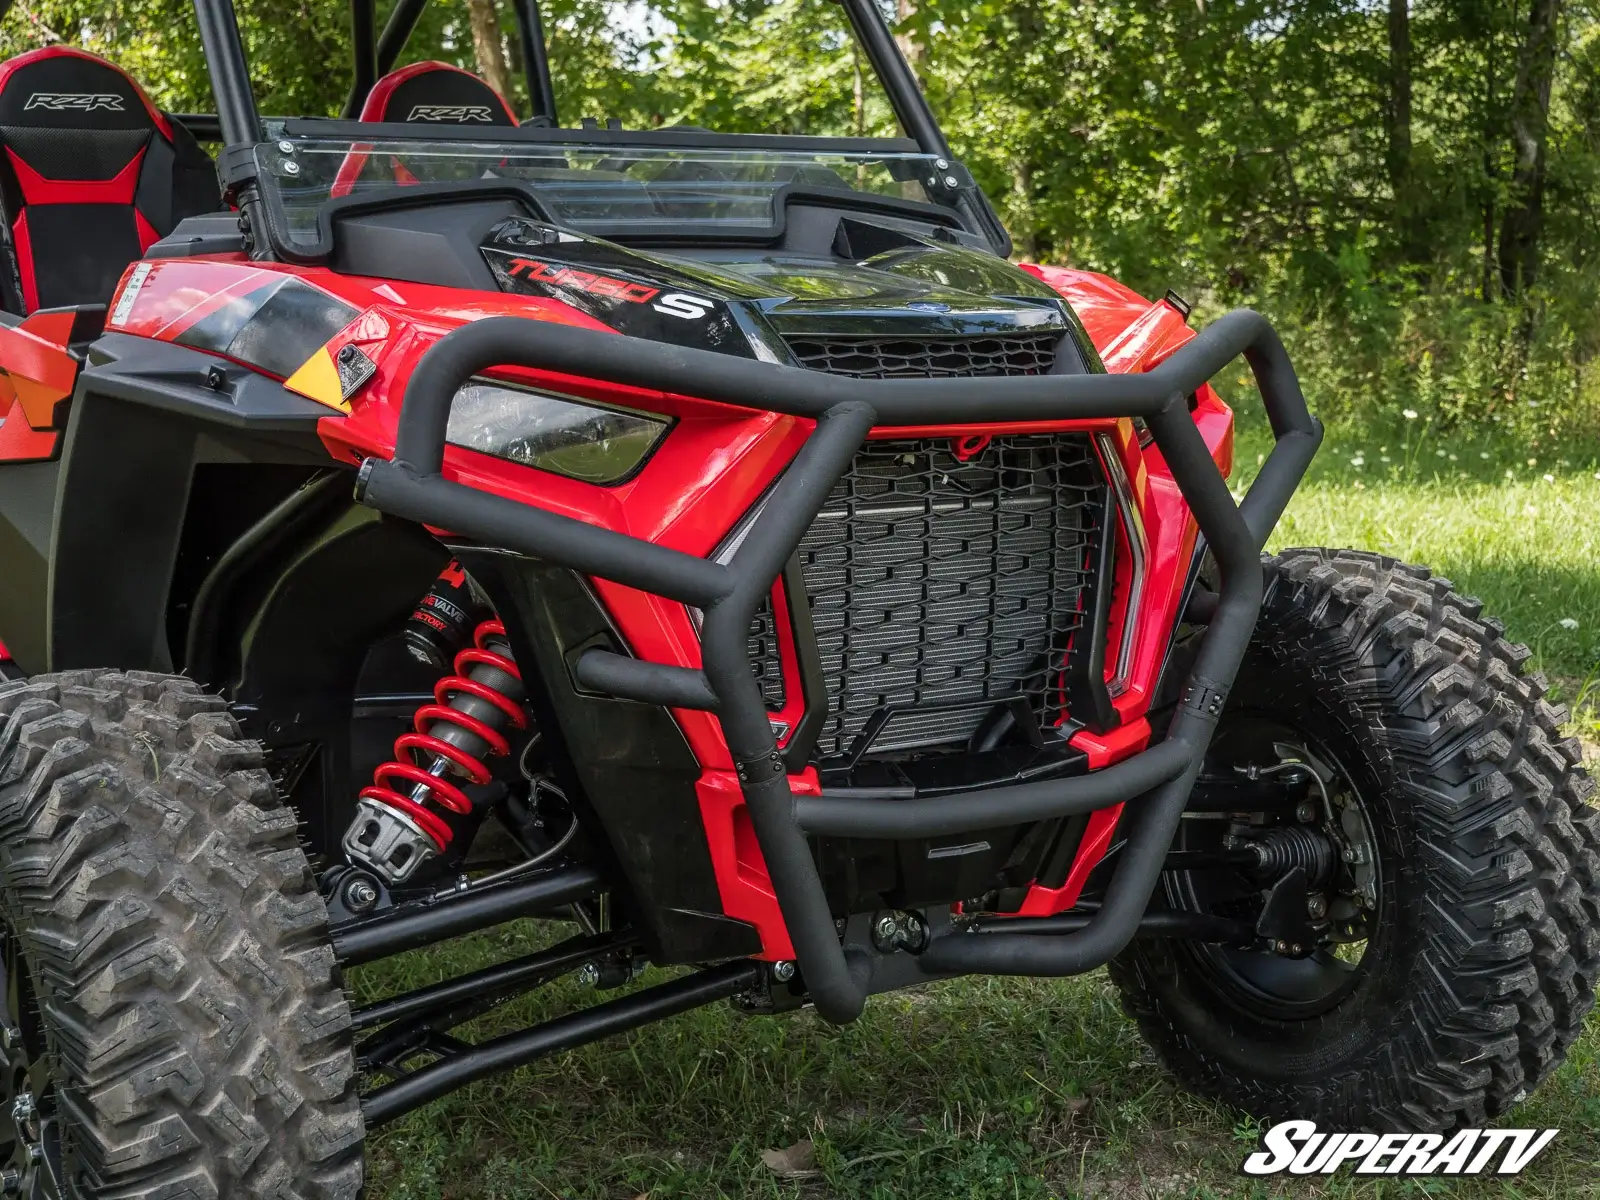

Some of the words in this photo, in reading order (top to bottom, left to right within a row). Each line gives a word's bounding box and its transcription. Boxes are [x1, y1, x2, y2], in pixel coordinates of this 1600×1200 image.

[23, 93, 126, 112] RZR
[406, 105, 493, 122] RZR
[507, 258, 660, 304] TURBO
[653, 293, 714, 320] S
[411, 610, 448, 632] ACTORY
